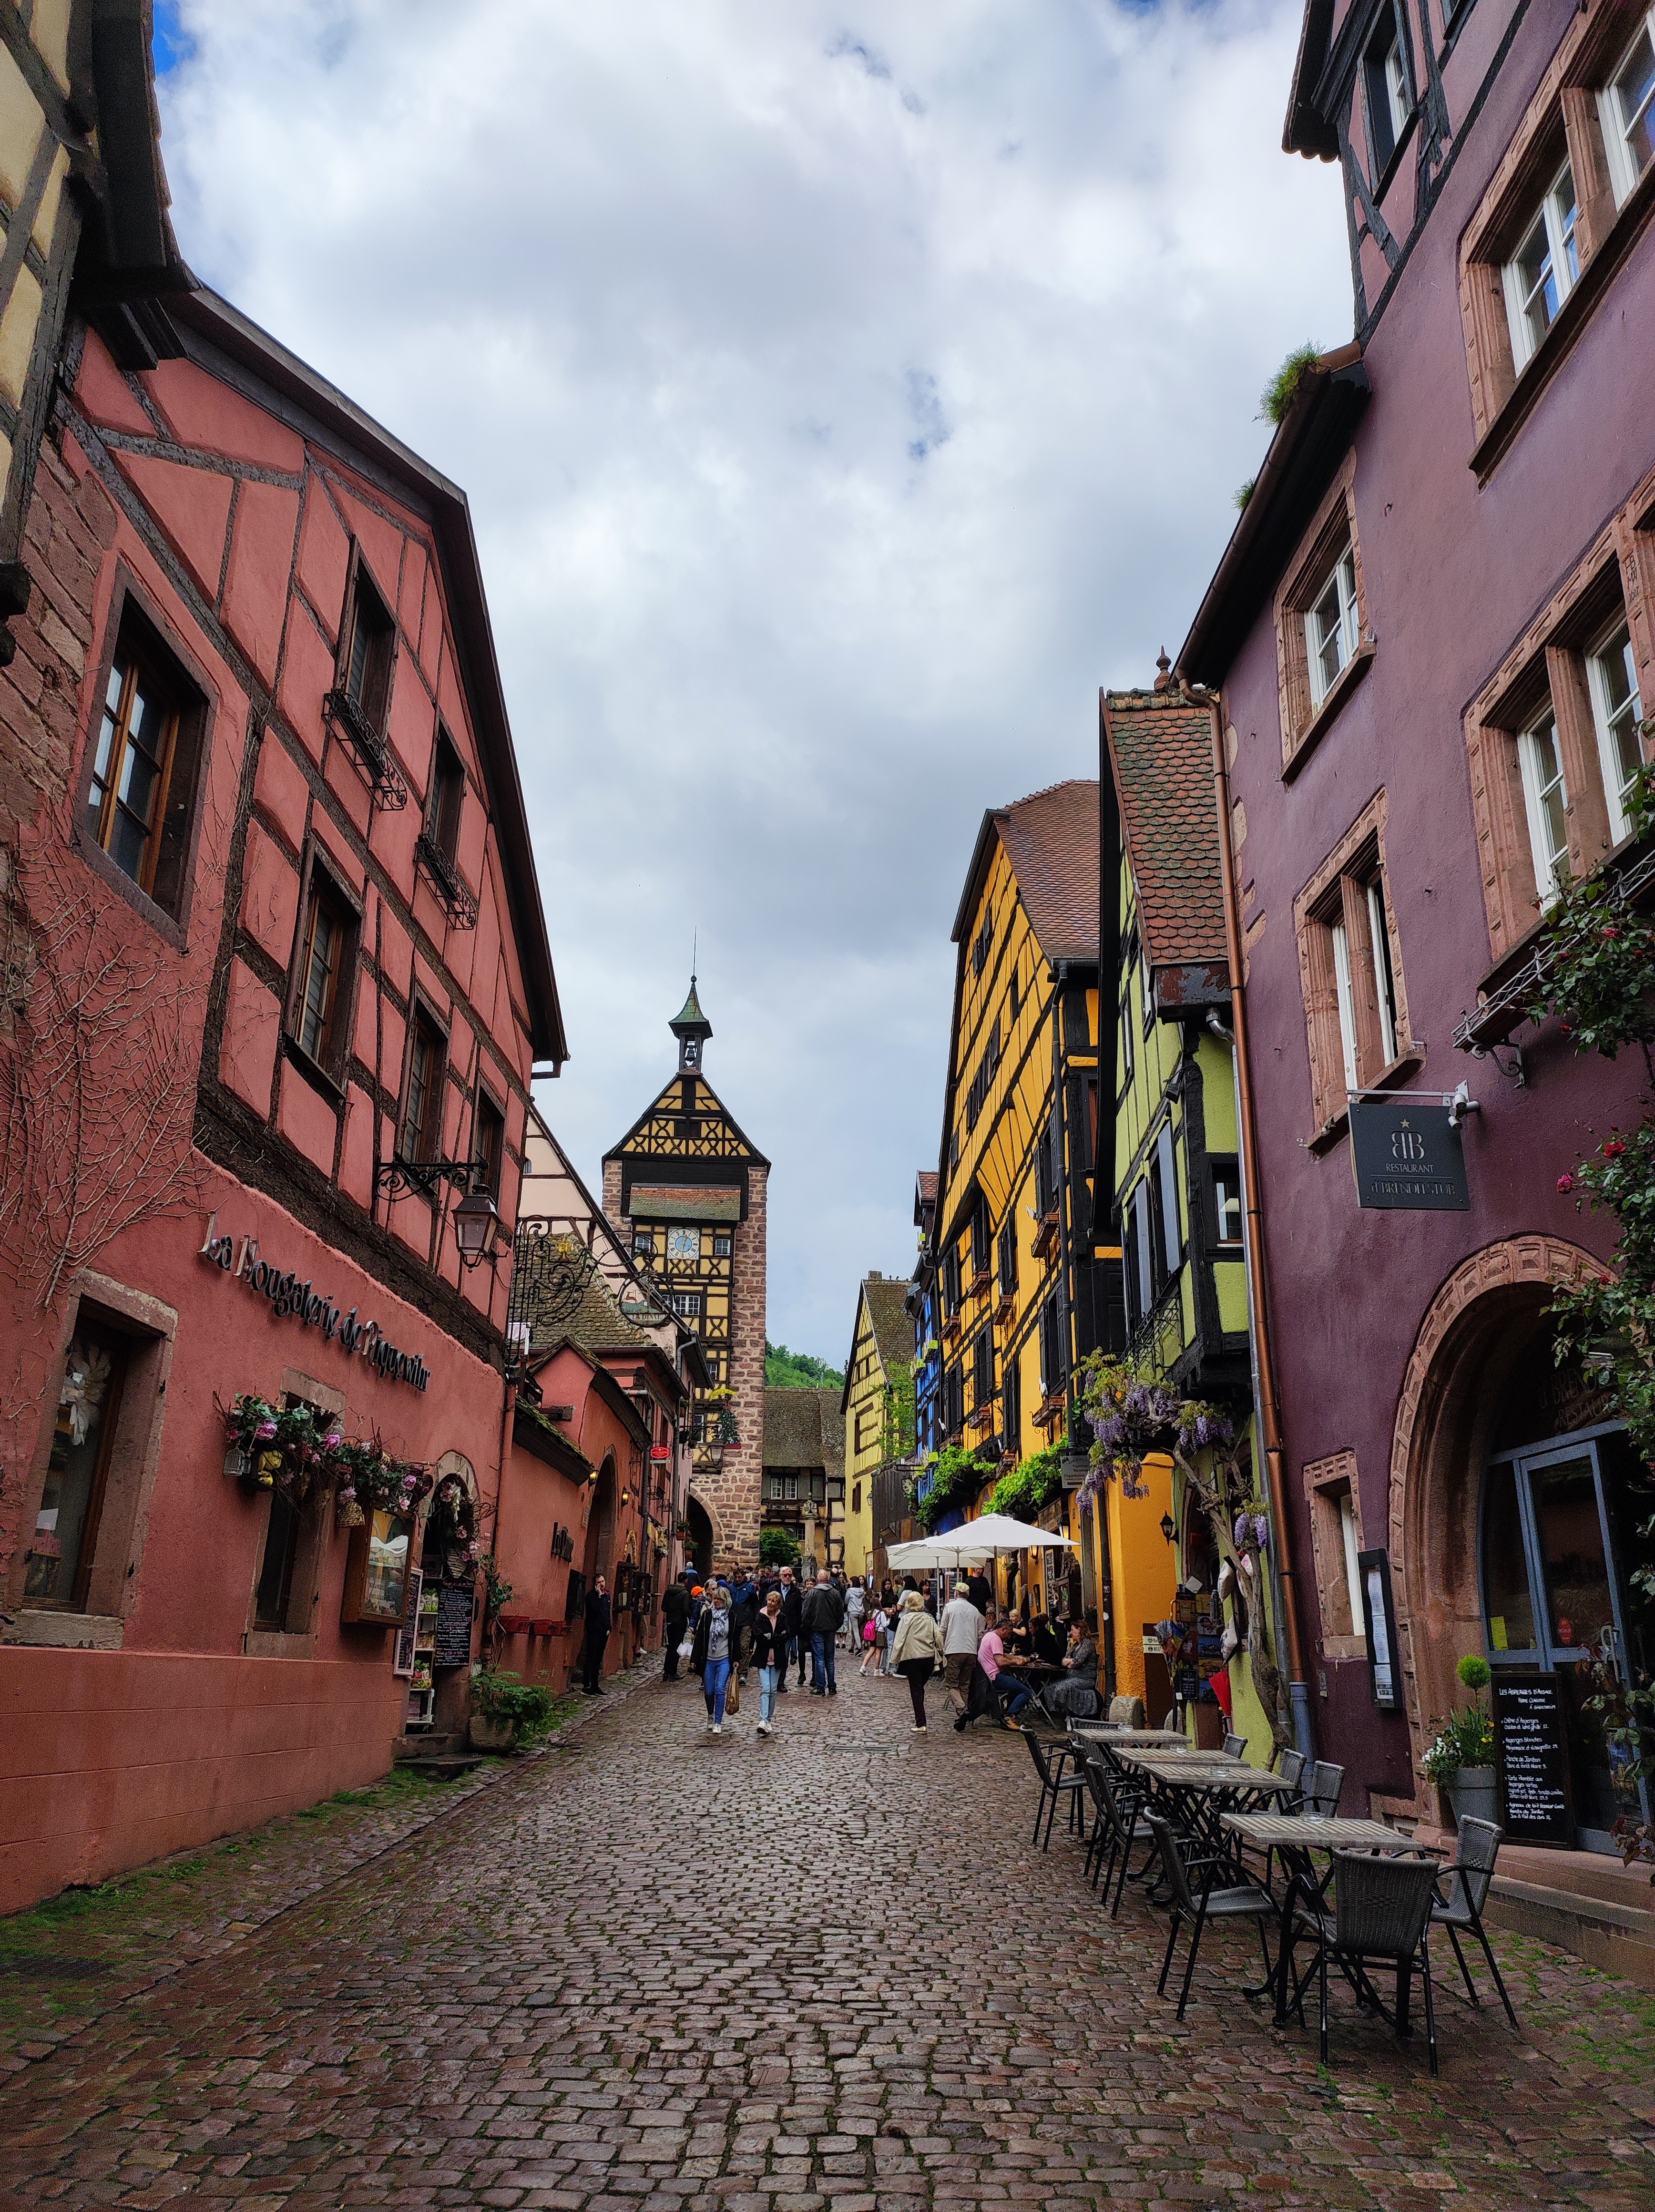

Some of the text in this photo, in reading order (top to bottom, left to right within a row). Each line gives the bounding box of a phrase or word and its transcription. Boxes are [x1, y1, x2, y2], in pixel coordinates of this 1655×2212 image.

[1386, 1163, 1434, 1173] RESTAURANT
[197, 1211, 234, 1271] La
[232, 1233, 340, 1339] Nougaterie
[339, 1305, 361, 1353] de
